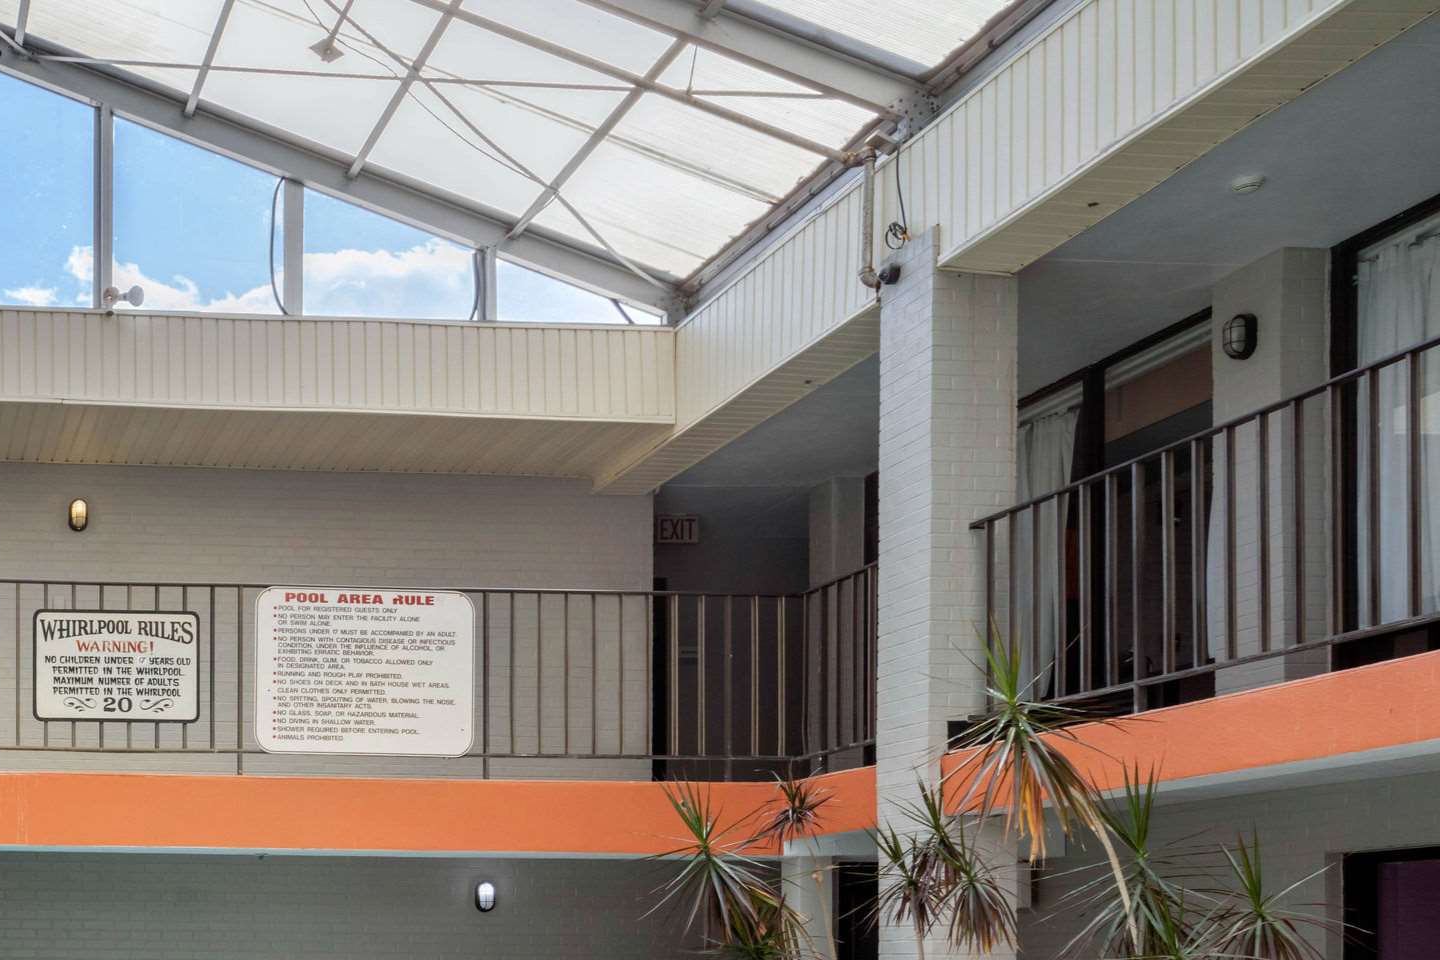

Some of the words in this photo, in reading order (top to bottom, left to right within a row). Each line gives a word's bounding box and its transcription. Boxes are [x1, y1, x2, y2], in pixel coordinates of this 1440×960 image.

[660, 518, 696, 540] EXIT
[284, 593, 328, 603] POOL
[337, 594, 383, 605] AREA
[40, 619, 132, 642] WHIRLPOOL
[137, 620, 194, 645] RULES
[76, 639, 154, 655] WARNING!
[44, 656, 56, 664] NO
[60, 656, 100, 664] CHILDREN
[104, 656, 134, 665] UNDER
[149, 657, 174, 666] YEARS
[176, 658, 191, 666] OLD
[52, 666, 98, 674] PERMITTED
[104, 666, 112, 675] IN
[116, 667, 132, 675] THE
[53, 676, 94, 685] MAXIMUM
[98, 677, 131, 686] NUMBER
[134, 678, 145, 686] OF
[147, 678, 180, 686] ADULTS
[52, 687, 100, 696] PERMITTED
[104, 687, 112, 696] IN
[117, 688, 132, 696] THE
[136, 688, 181, 697] WHIRLPOOL
[103, 696, 133, 713] 20
